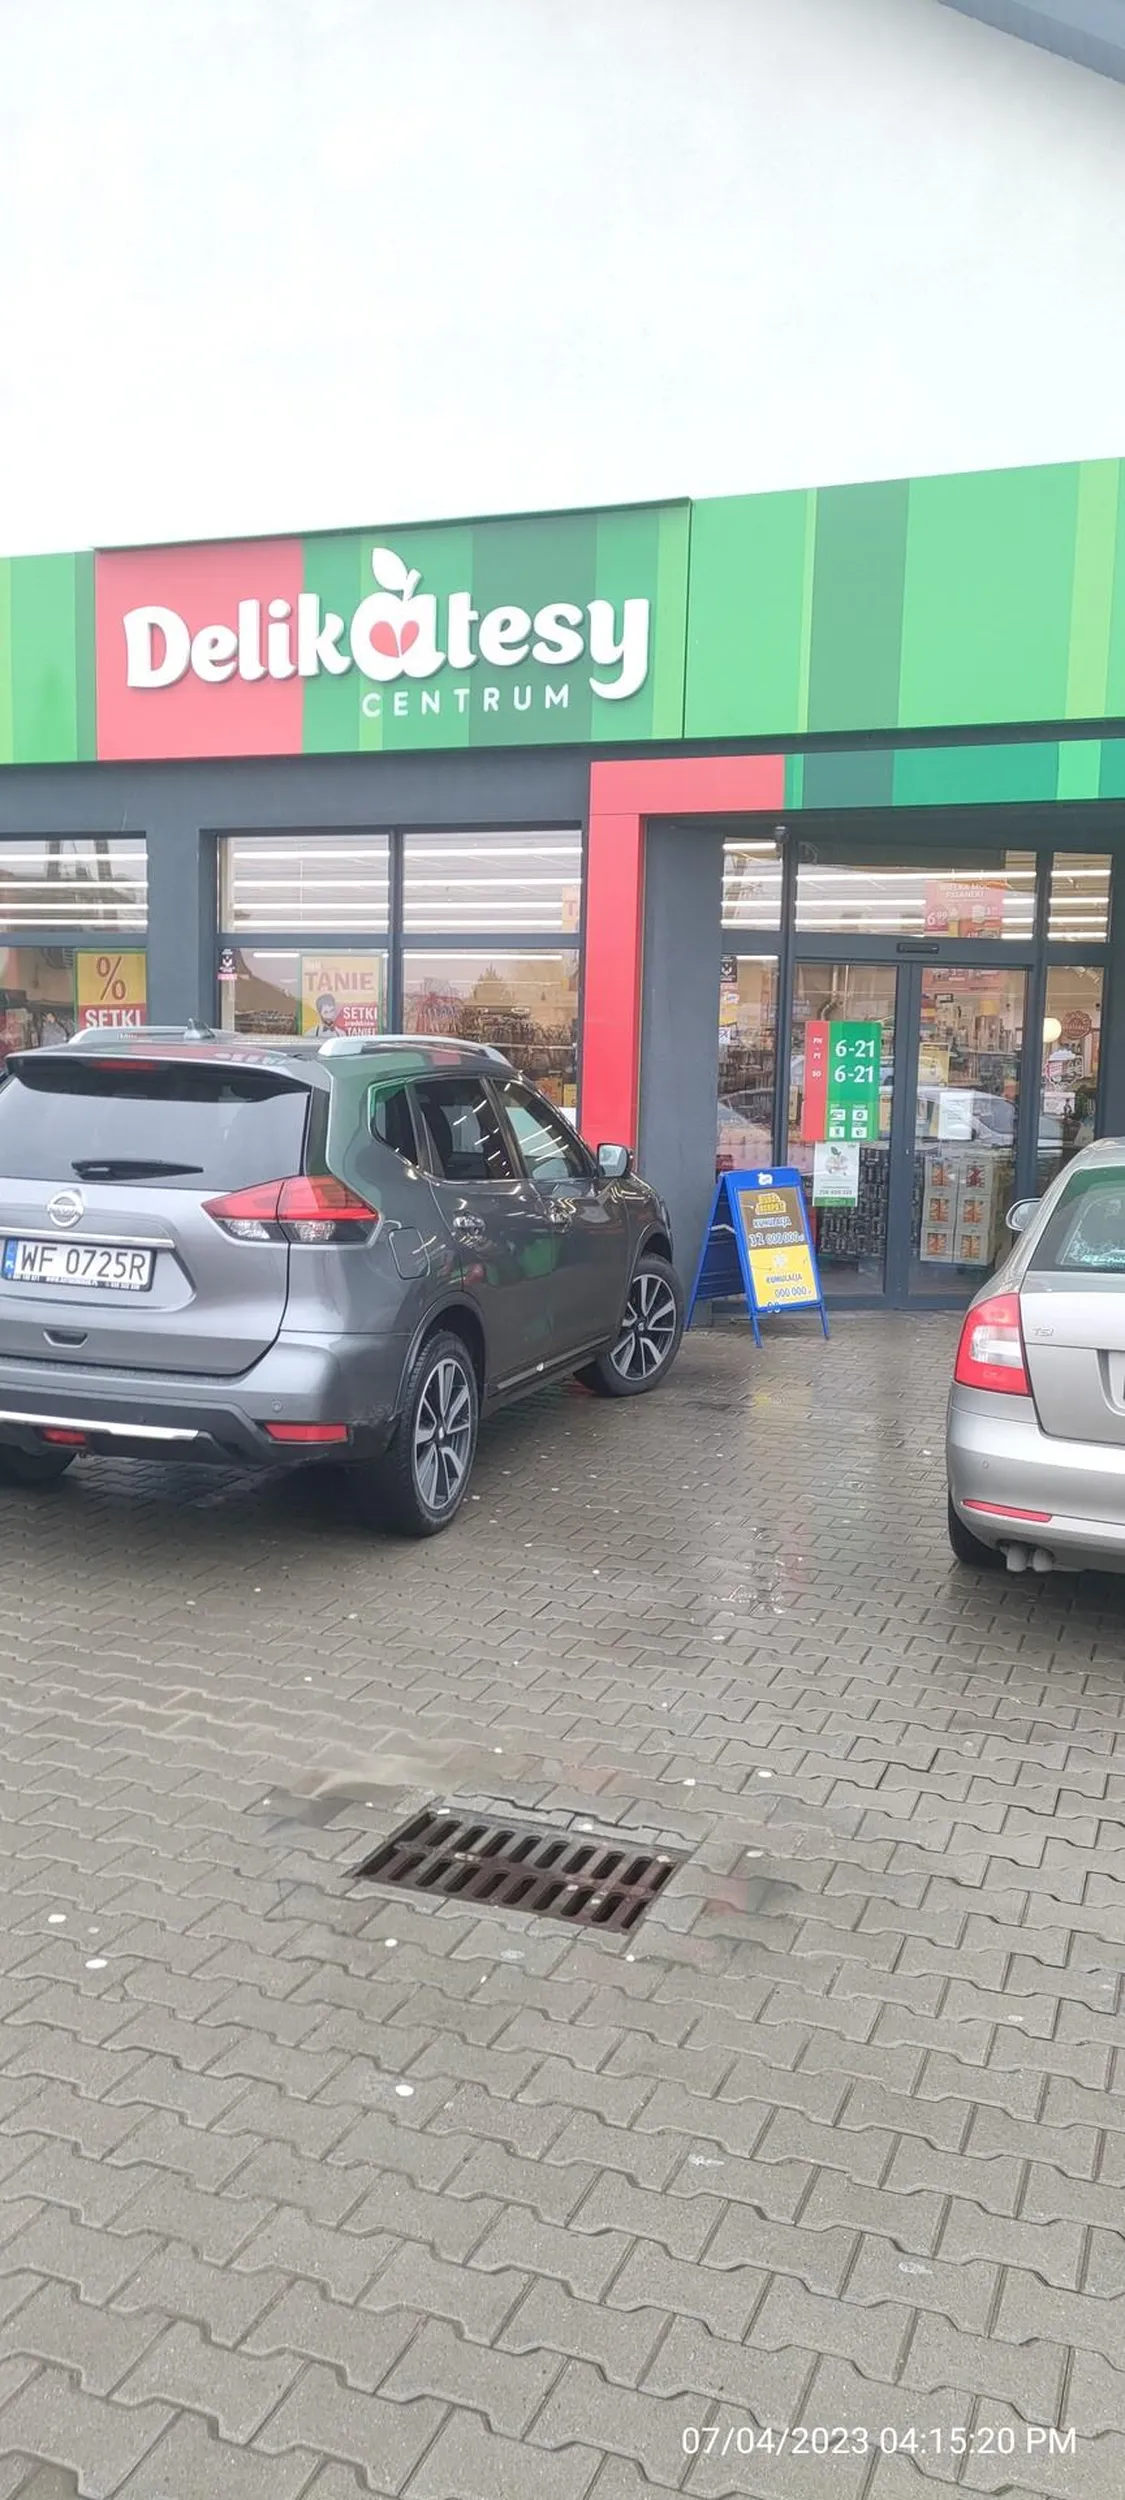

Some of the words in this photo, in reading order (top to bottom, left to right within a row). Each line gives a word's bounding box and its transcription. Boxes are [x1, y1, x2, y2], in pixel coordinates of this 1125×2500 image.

[122, 590, 650, 700] Delikatesy
[362, 684, 569, 717] CENTRUM
[96, 956, 127, 1001] %
[304, 971, 375, 993] TANIE
[84, 1008, 141, 1029] SETKI
[342, 1006, 378, 1020] SETKI
[835, 1039, 875, 1058] 6-21
[834, 1065, 874, 1083] 6-21
[20, 1244, 58, 1273] WF
[65, 1248, 147, 1282] 0725R
[1032, 1327, 1054, 1337] TSI
